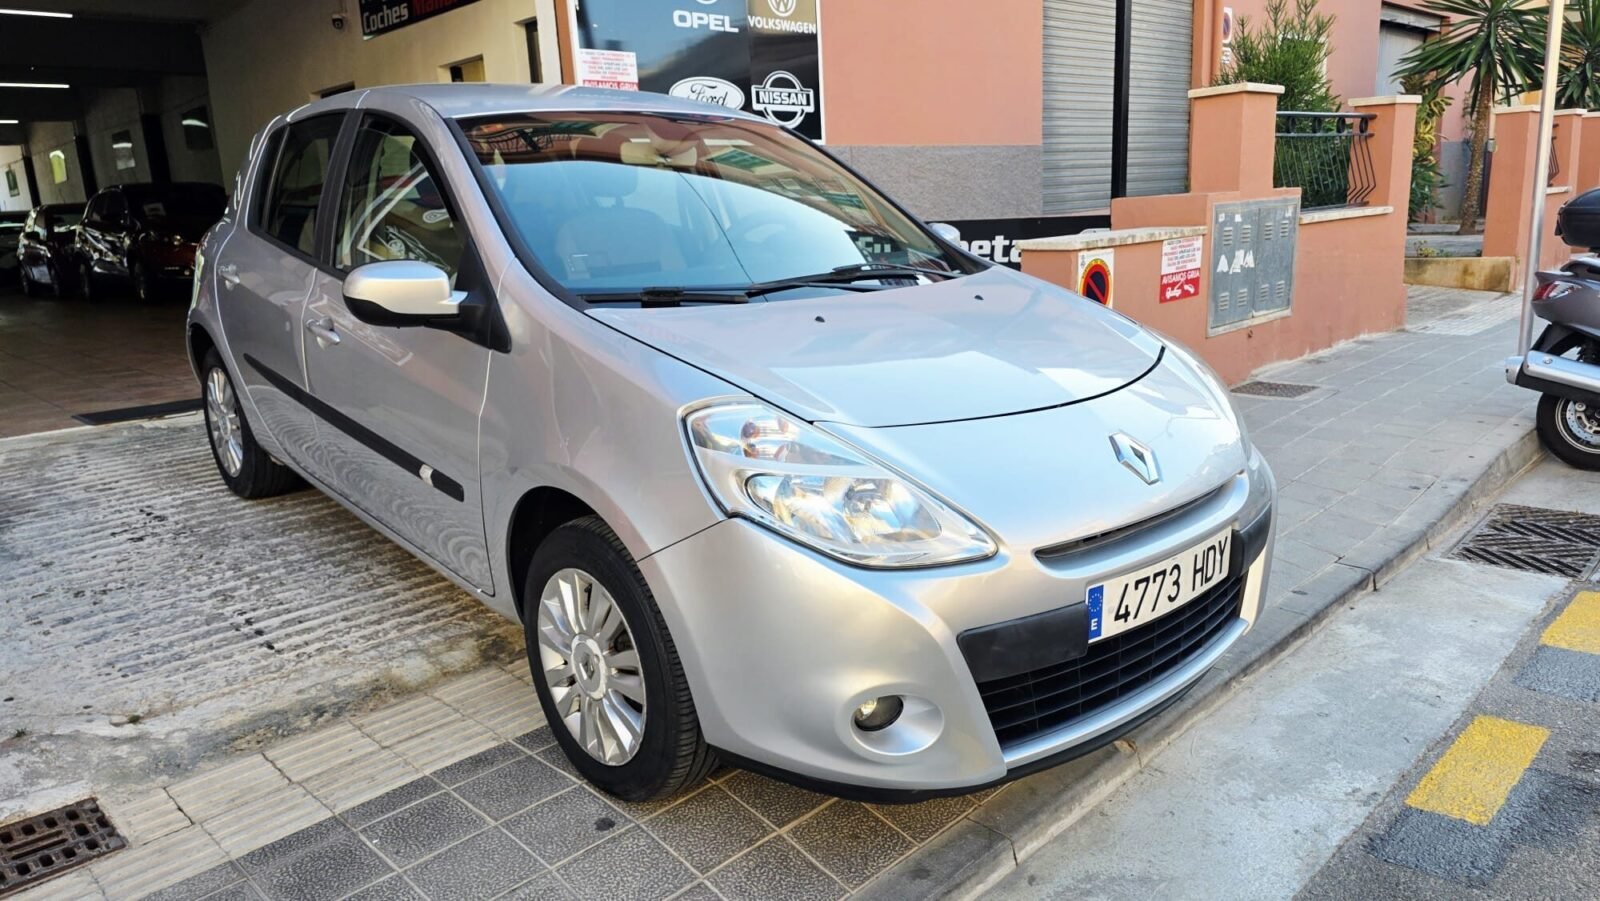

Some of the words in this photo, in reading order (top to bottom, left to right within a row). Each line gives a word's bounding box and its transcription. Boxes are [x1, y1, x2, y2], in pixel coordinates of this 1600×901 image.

[362, 3, 409, 33] Coches
[673, 10, 740, 33] OPEL
[748, 15, 817, 34] VOLKSWAGEN
[687, 83, 729, 106] Ford
[758, 90, 807, 106] NISSAN
[1113, 564, 1182, 623] 4773
[1192, 536, 1228, 592] HDY
[1090, 618, 1098, 631] E
